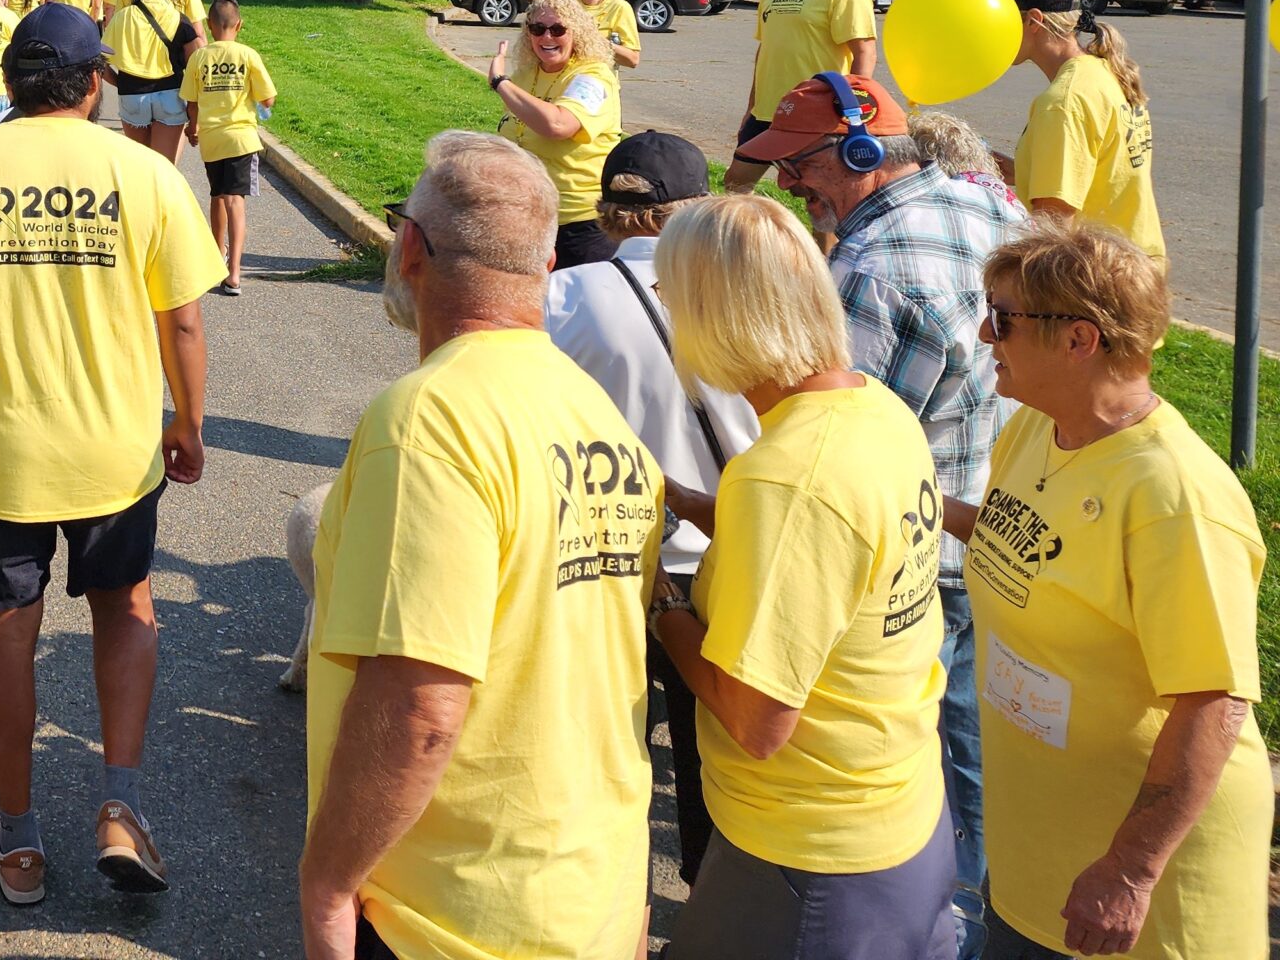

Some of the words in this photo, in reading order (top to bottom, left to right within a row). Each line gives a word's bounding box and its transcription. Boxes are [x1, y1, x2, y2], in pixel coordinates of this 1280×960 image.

[212, 63, 245, 75] 2024
[852, 148, 874, 159] JBL
[22, 186, 120, 222] 2024
[23, 223, 63, 232] World
[68, 222, 118, 236] Suicide
[85, 238, 116, 252] Day
[10, 254, 18, 262] IS
[20, 253, 60, 262] AVAILABLE:
[61, 254, 75, 262] Call
[84, 254, 99, 263] Text
[100, 256, 114, 265] 988
[986, 488, 1030, 523] CHANGE
[1023, 511, 1049, 542] THE
[977, 506, 1036, 559] NARRATIVE
[558, 564, 574, 583] HELP
[973, 557, 1024, 603] #StartTheConversation
[886, 616, 906, 633] HELP
[906, 610, 913, 625] IS
